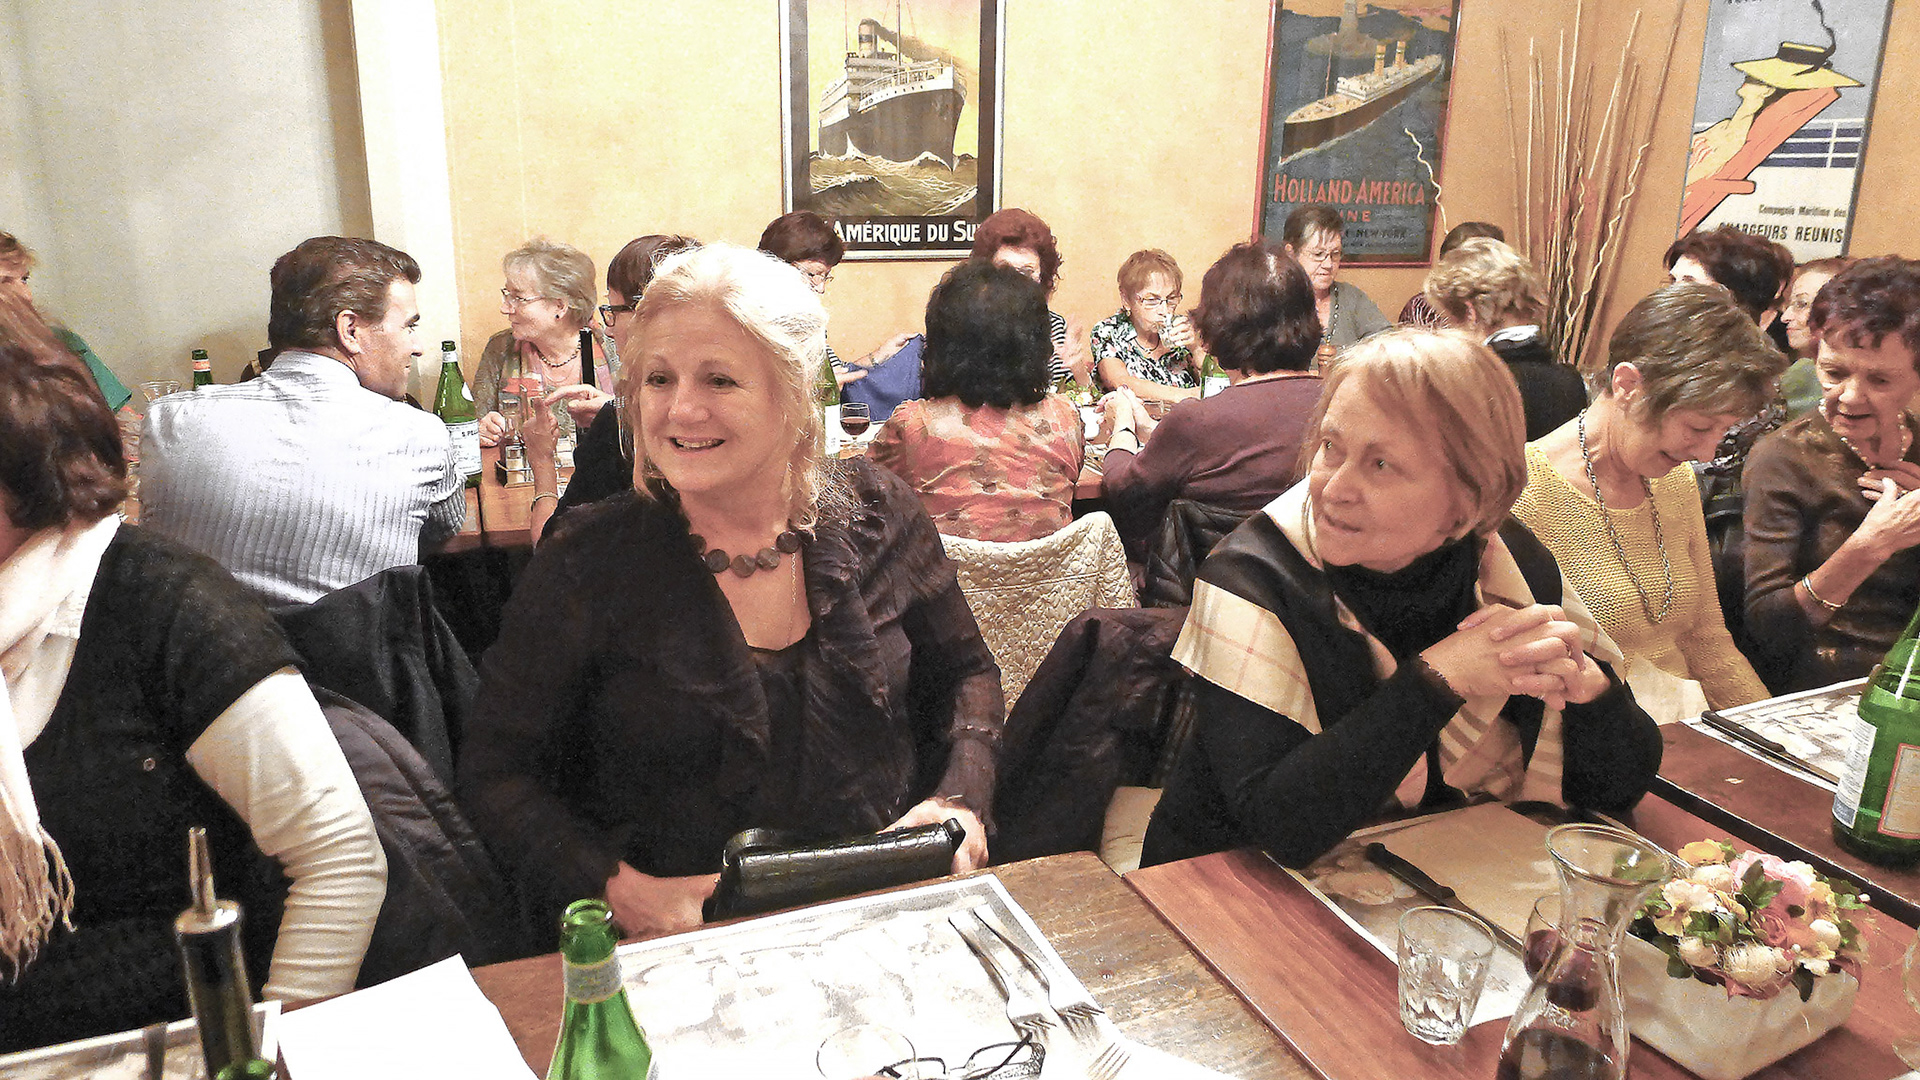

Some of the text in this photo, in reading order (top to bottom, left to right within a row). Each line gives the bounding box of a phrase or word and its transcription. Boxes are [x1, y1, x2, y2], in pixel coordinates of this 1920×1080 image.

[1340, 210, 1371, 222] INE
[927, 224, 949, 242] DU
[1795, 226, 1844, 243] REUNIS
